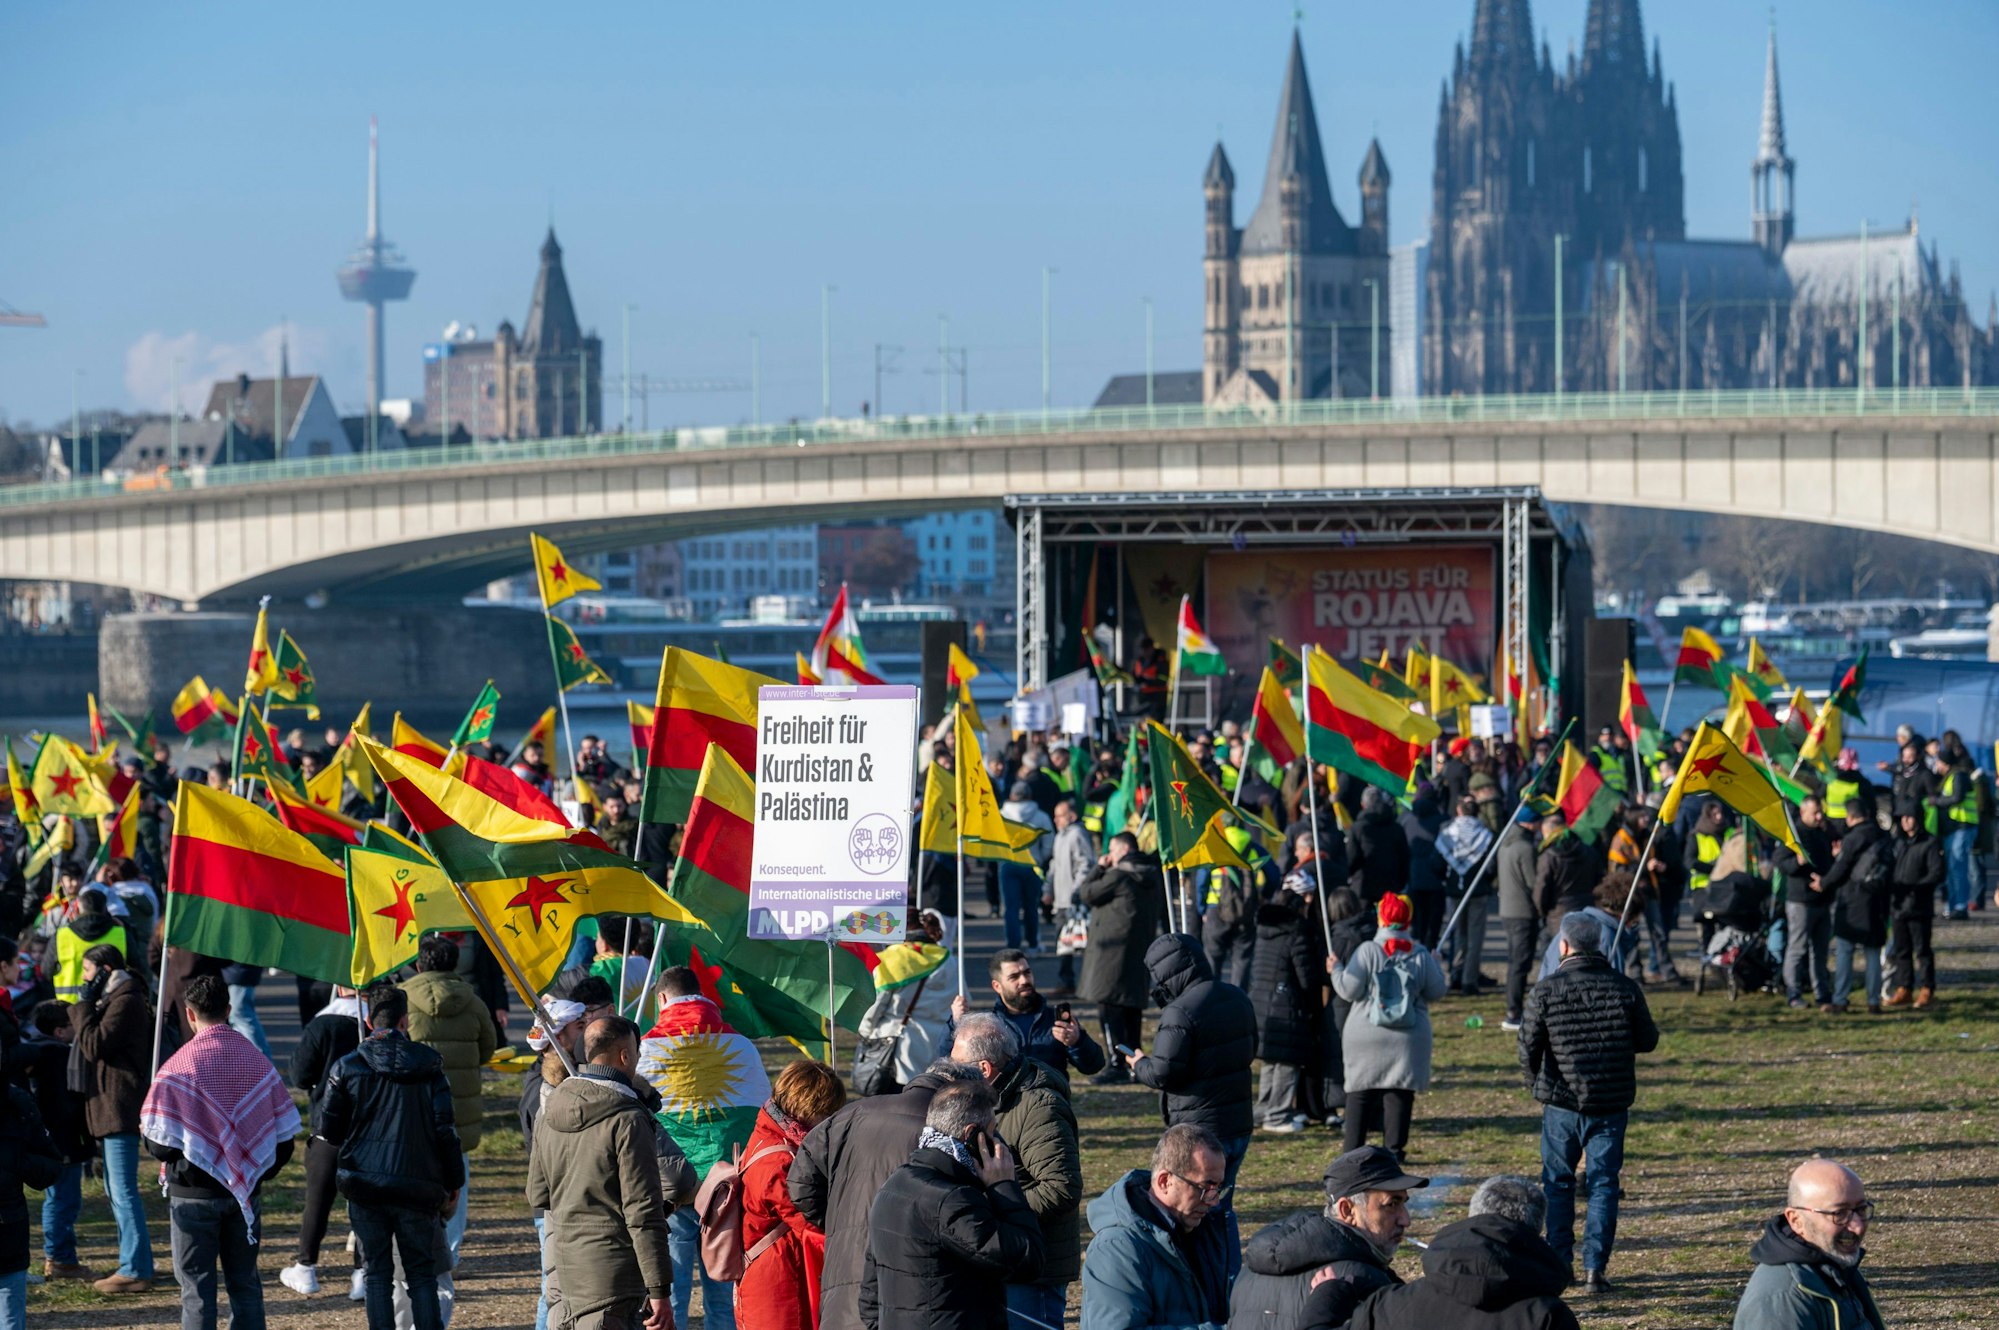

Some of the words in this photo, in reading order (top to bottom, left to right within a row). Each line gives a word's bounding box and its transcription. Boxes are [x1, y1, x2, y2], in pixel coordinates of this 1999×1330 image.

[1314, 569, 1409, 590] STATUS
[1420, 564, 1469, 589] FÜR
[1315, 592, 1474, 626] ROJAVA
[1341, 628, 1445, 660] JETZT
[763, 715, 834, 744] Freiheit
[839, 714, 867, 744] für
[762, 753, 853, 783] Kurdistan
[858, 752, 873, 782] &
[761, 792, 849, 821] Palästina
[759, 864, 827, 876] Konsequent.
[758, 887, 872, 901] Internationalistische
[875, 888, 902, 901] Liste
[756, 910, 829, 935] MLPD
